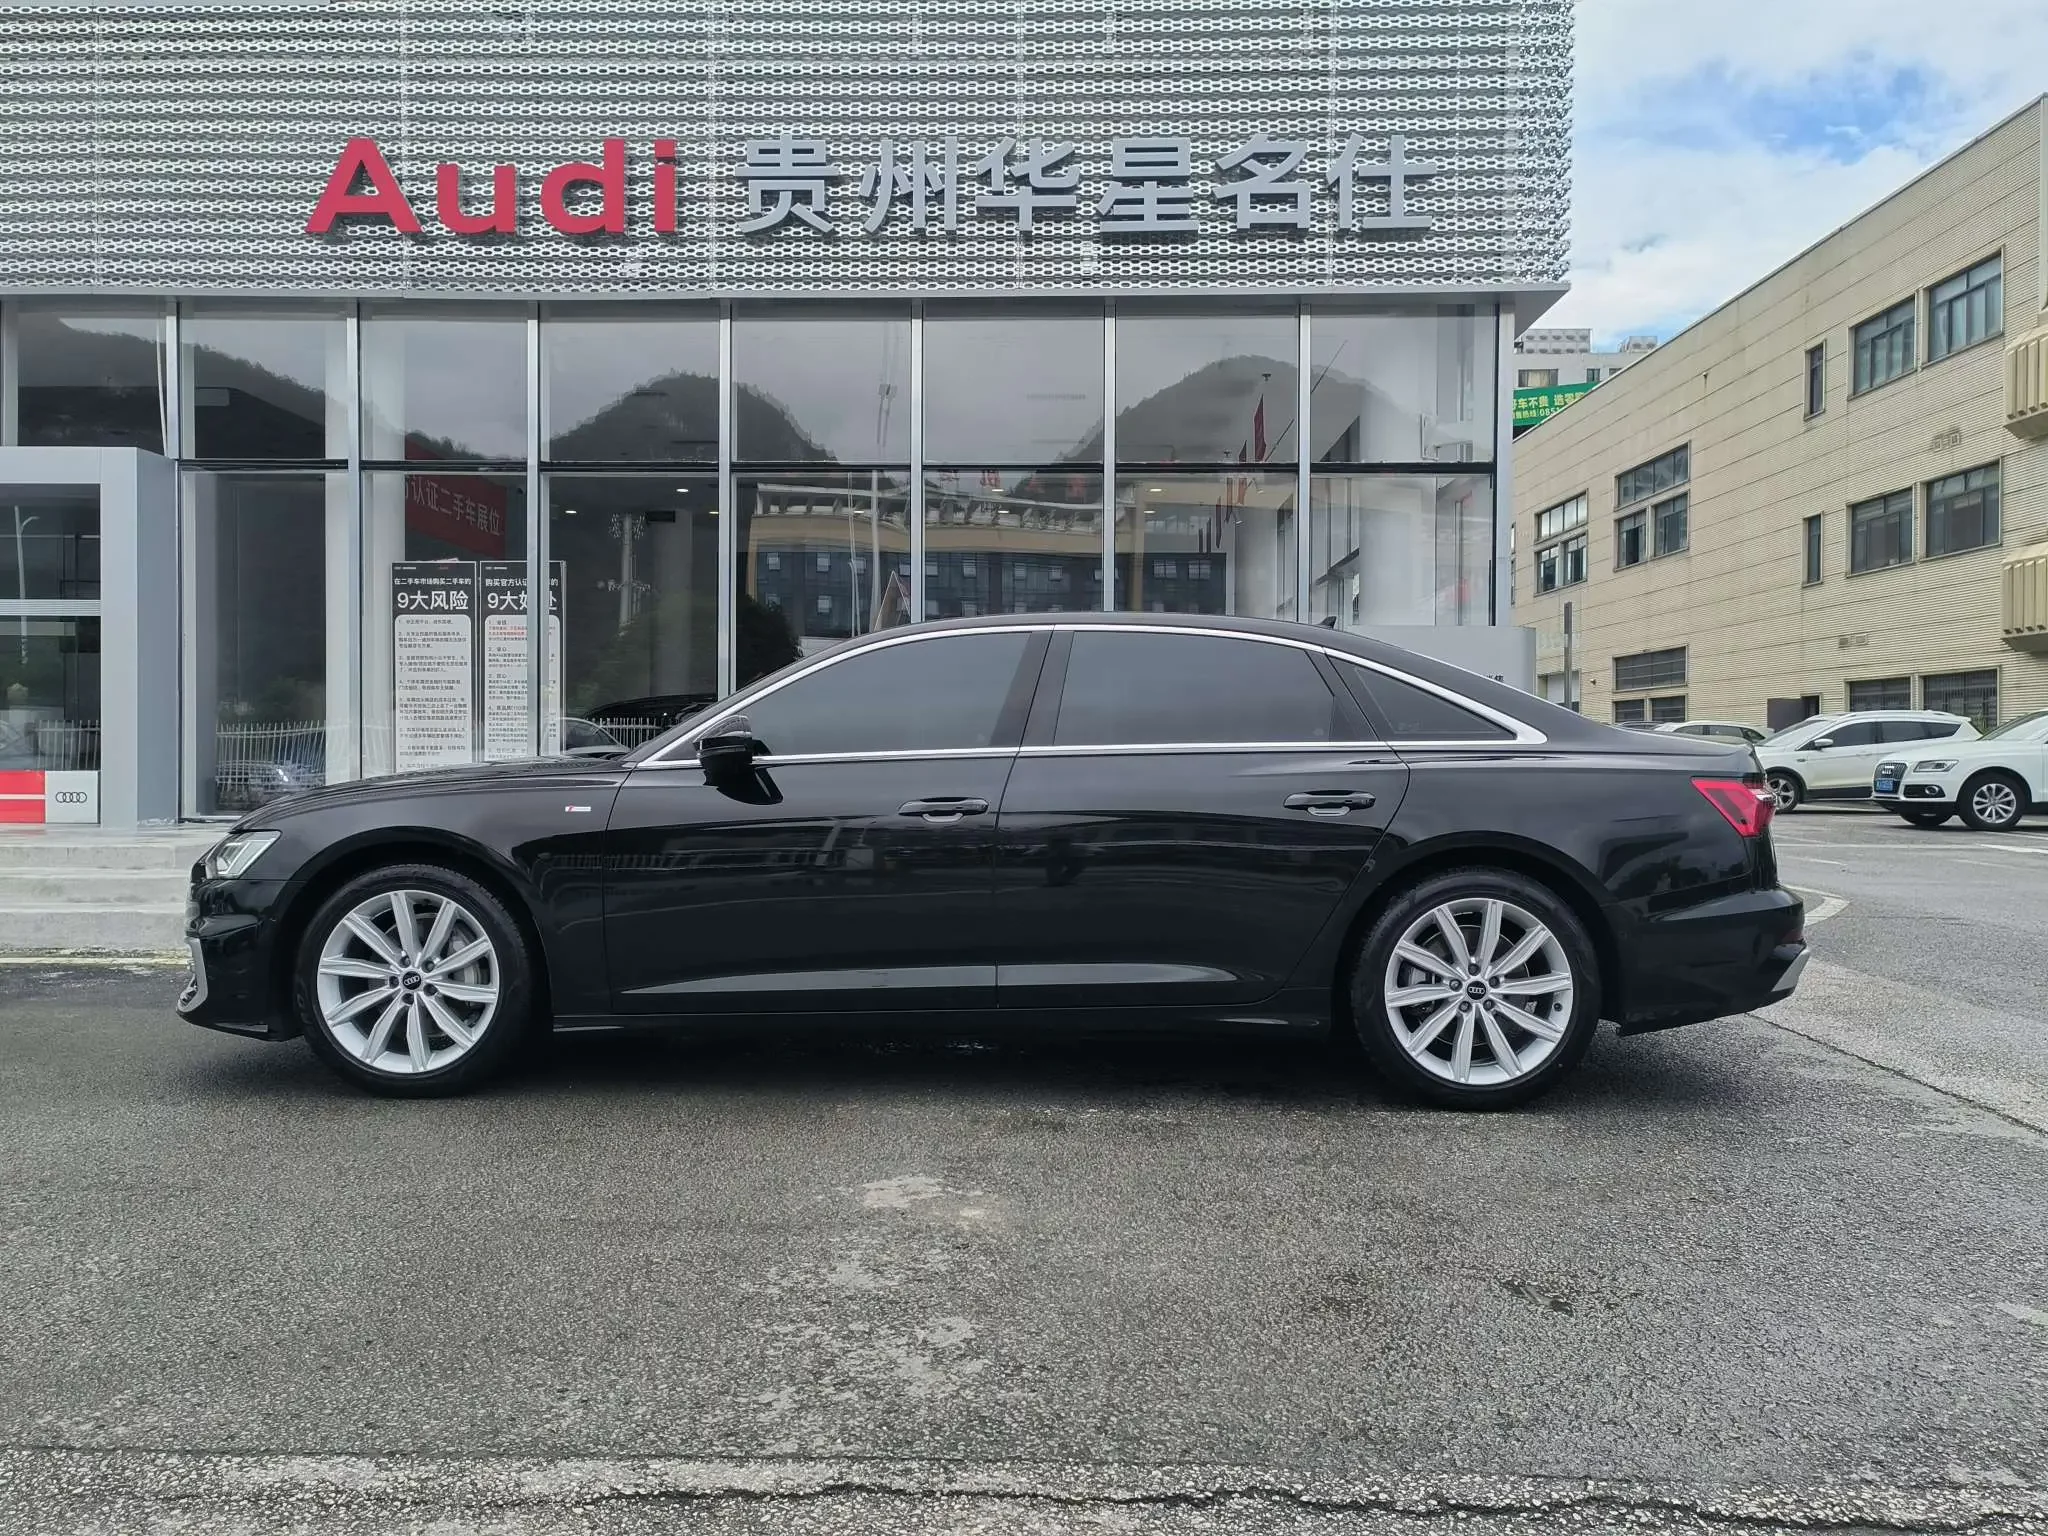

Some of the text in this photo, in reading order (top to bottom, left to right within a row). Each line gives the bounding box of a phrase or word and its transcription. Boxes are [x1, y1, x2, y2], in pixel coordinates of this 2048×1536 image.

[305, 132, 1437, 236] Audi 贵州华星名仕
[397, 590, 469, 611] 9大风险
